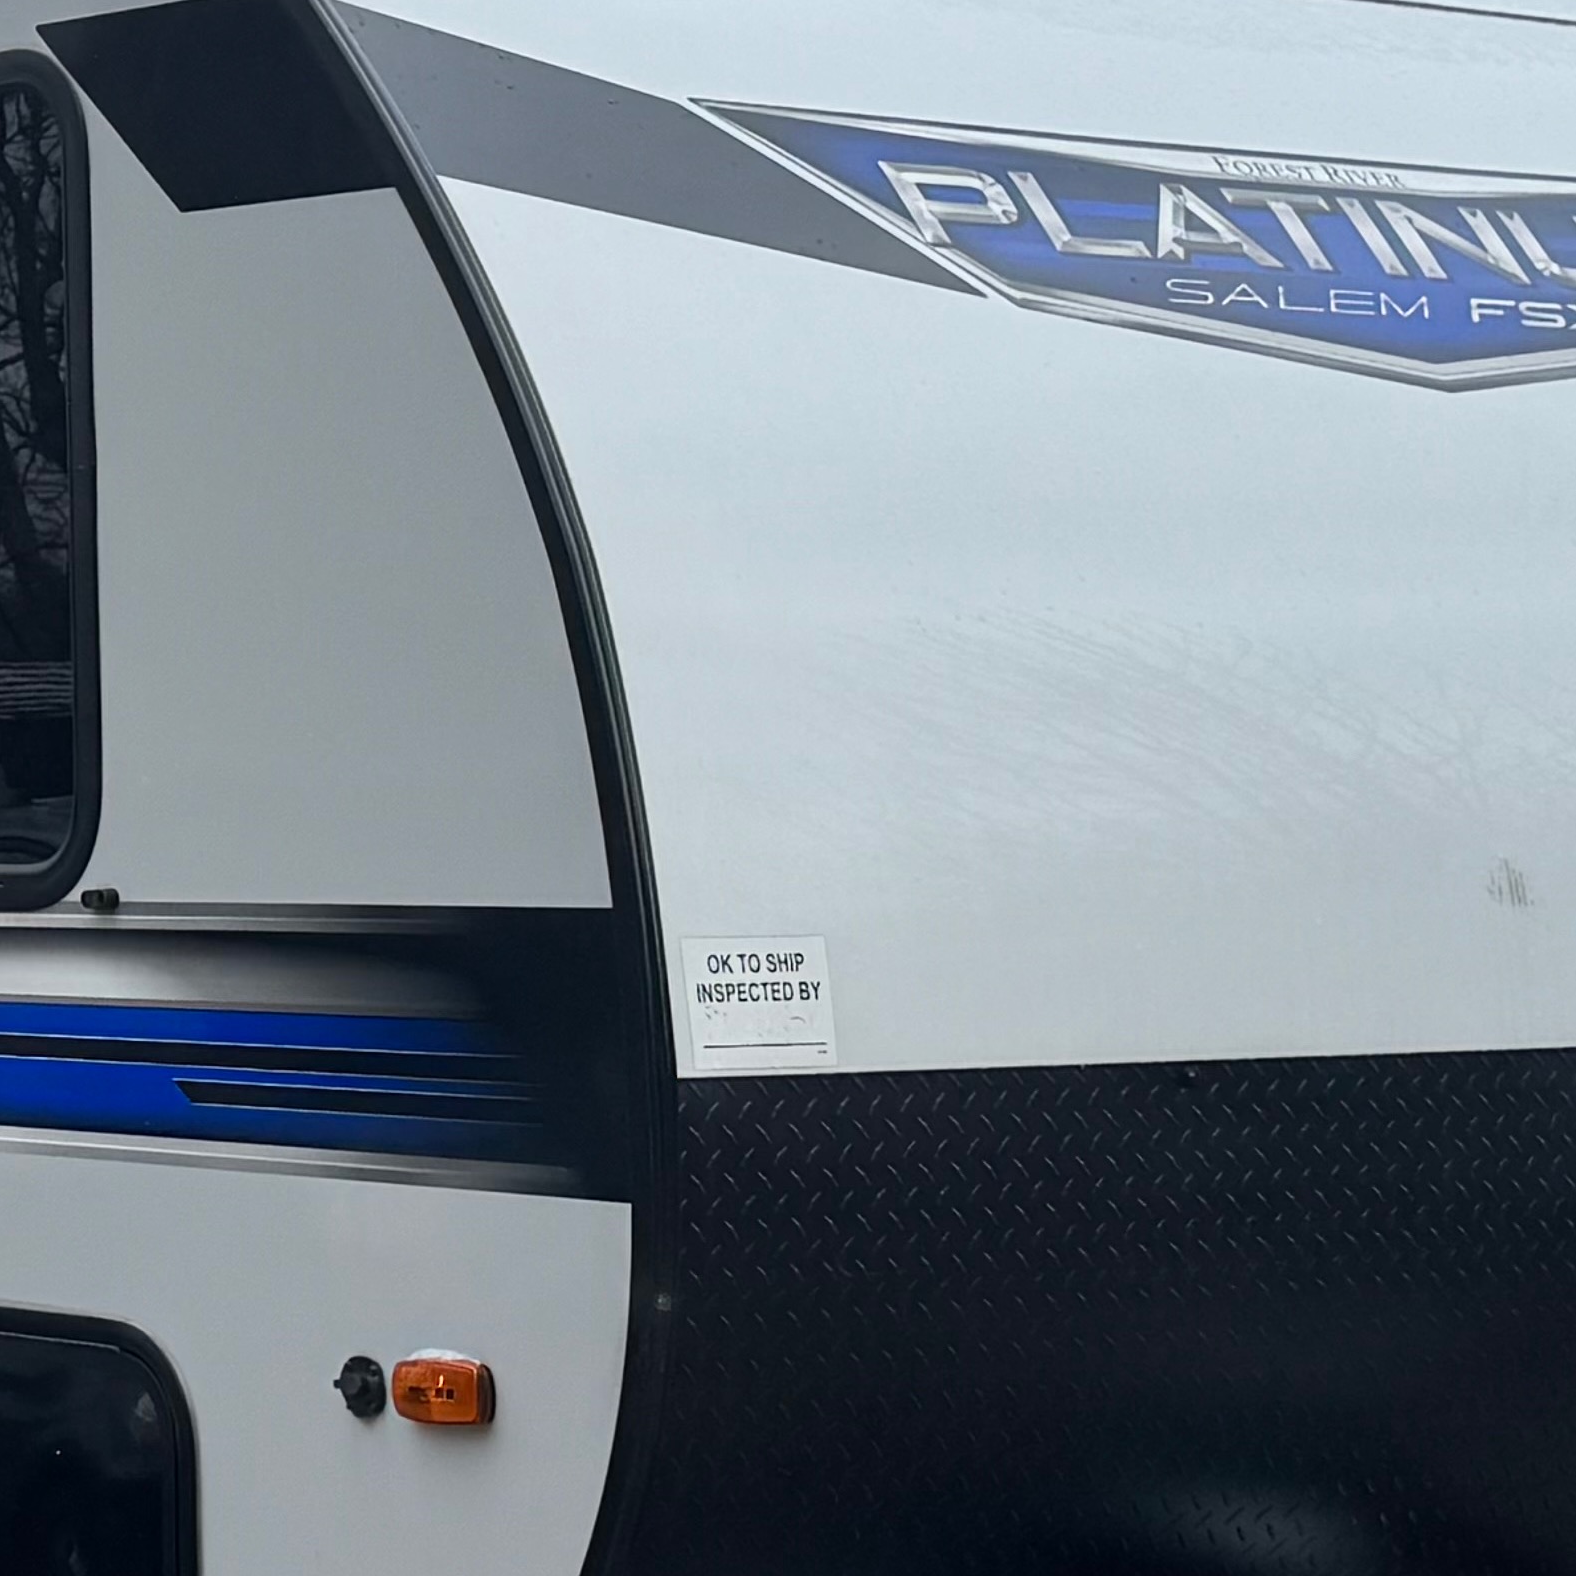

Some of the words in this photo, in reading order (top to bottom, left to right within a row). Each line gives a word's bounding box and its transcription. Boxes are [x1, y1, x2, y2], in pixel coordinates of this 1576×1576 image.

[1211, 155, 1317, 181] FOREST
[1320, 163, 1405, 188] RIVER
[1167, 278, 1430, 320] SALEM
[1470, 297, 1576, 329] FS
[706, 954, 734, 975] OK
[737, 953, 761, 973] TO
[766, 952, 805, 973] SHIP
[696, 982, 794, 1003] INSPECTED
[799, 981, 821, 1001] BY
